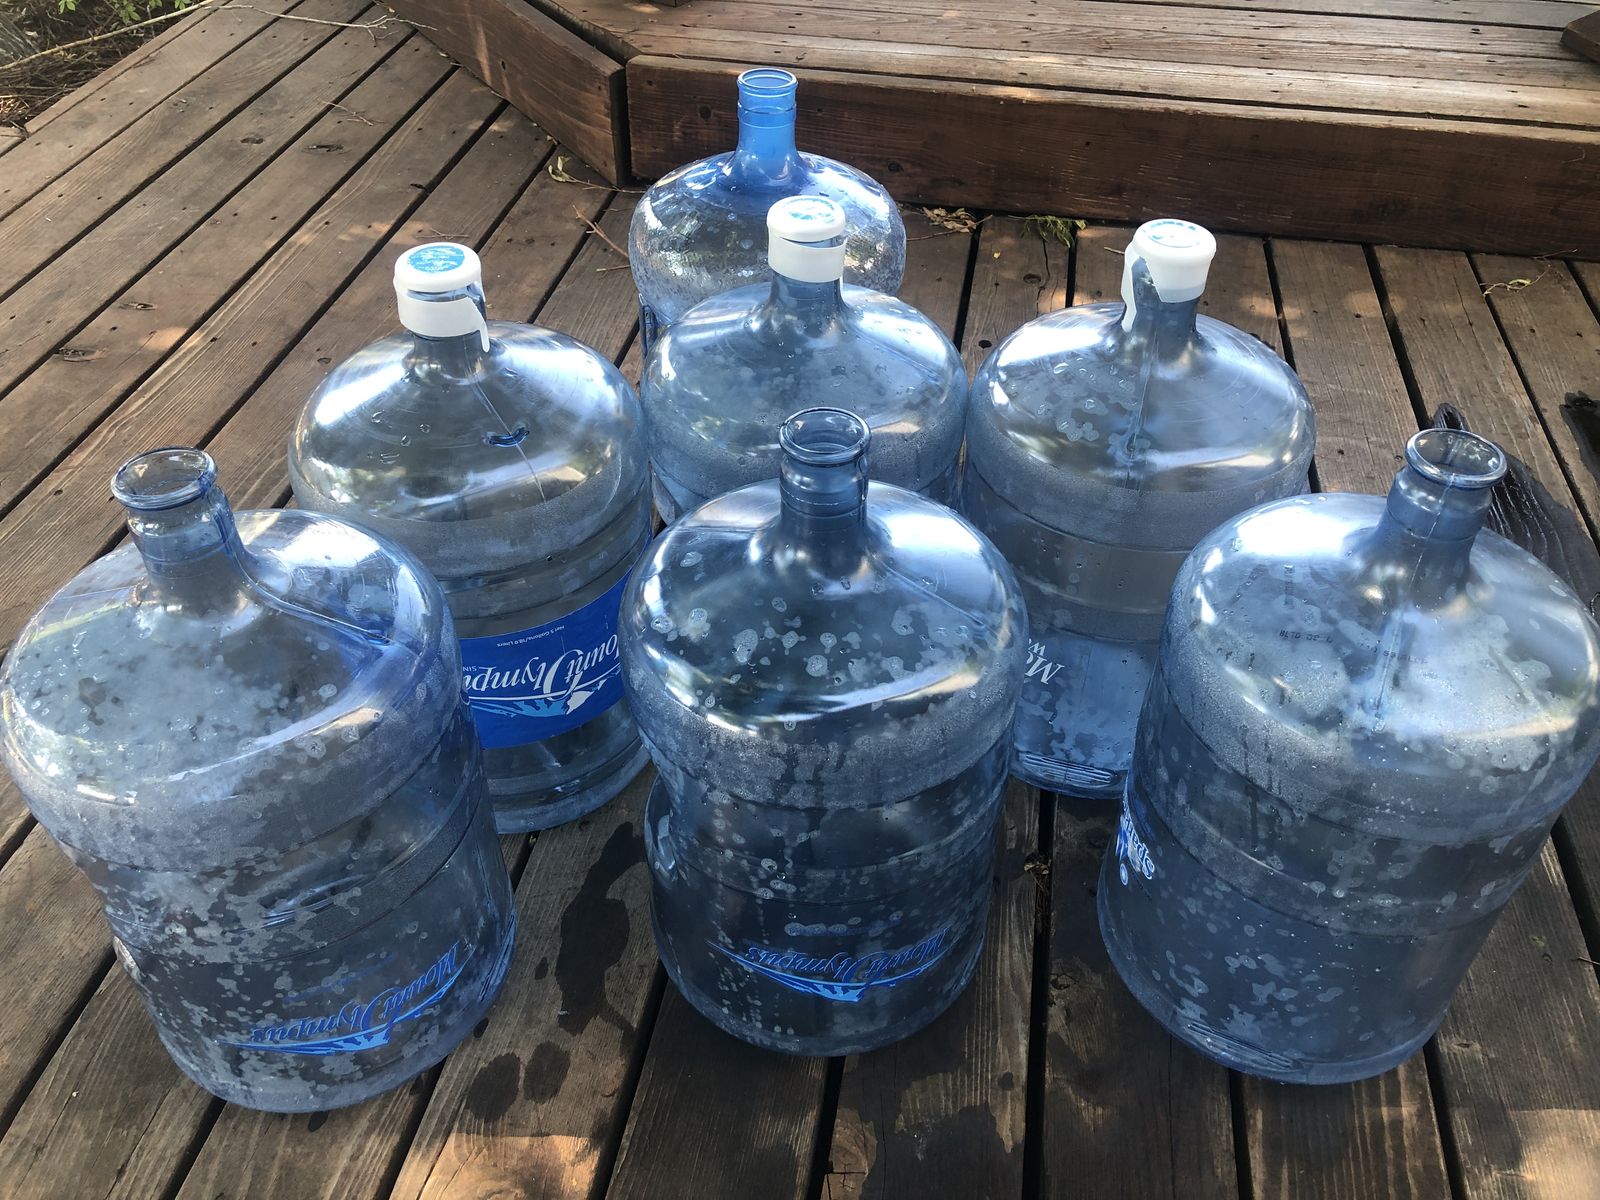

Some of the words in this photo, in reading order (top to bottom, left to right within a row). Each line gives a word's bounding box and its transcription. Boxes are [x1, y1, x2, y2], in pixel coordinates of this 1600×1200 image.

[462, 665, 478, 673] SIN
[463, 648, 583, 702] Olymp
[383, 939, 461, 1018] Mount
[745, 946, 889, 983] Olympus
[865, 925, 951, 979] Mount
[249, 986, 402, 1042] Olympus
